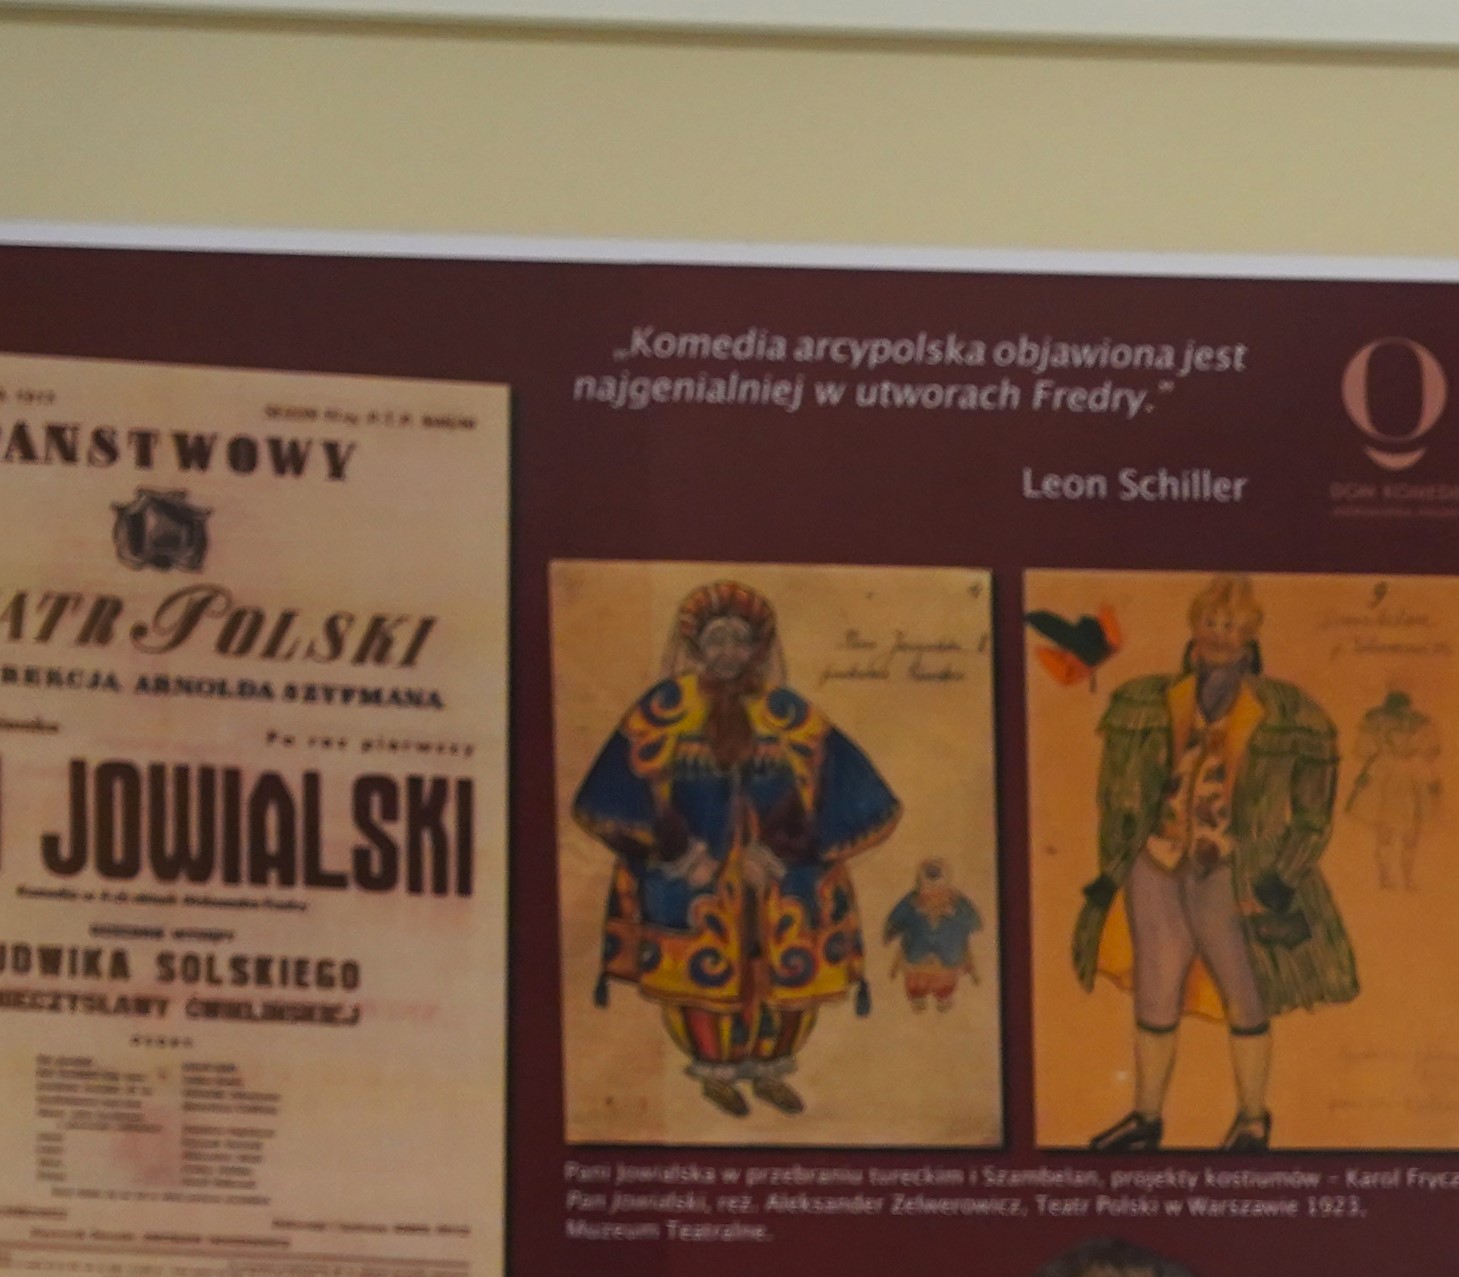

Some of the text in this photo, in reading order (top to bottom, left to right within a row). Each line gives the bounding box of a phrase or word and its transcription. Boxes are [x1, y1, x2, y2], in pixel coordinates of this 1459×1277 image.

[614, 327, 1247, 376] „Komedia arcypolska objawiona jest
[574, 371, 803, 412] najgenialniej
[815, 383, 845, 405] w
[856, 379, 1020, 409] utworach
[0, 421, 356, 480] ANSTWOWY
[1023, 468, 1247, 501] Leon Schiller
[40, 759, 474, 897] JOWIALSKI
[0, 943, 360, 991] DWIKA SOLSKIEGO
